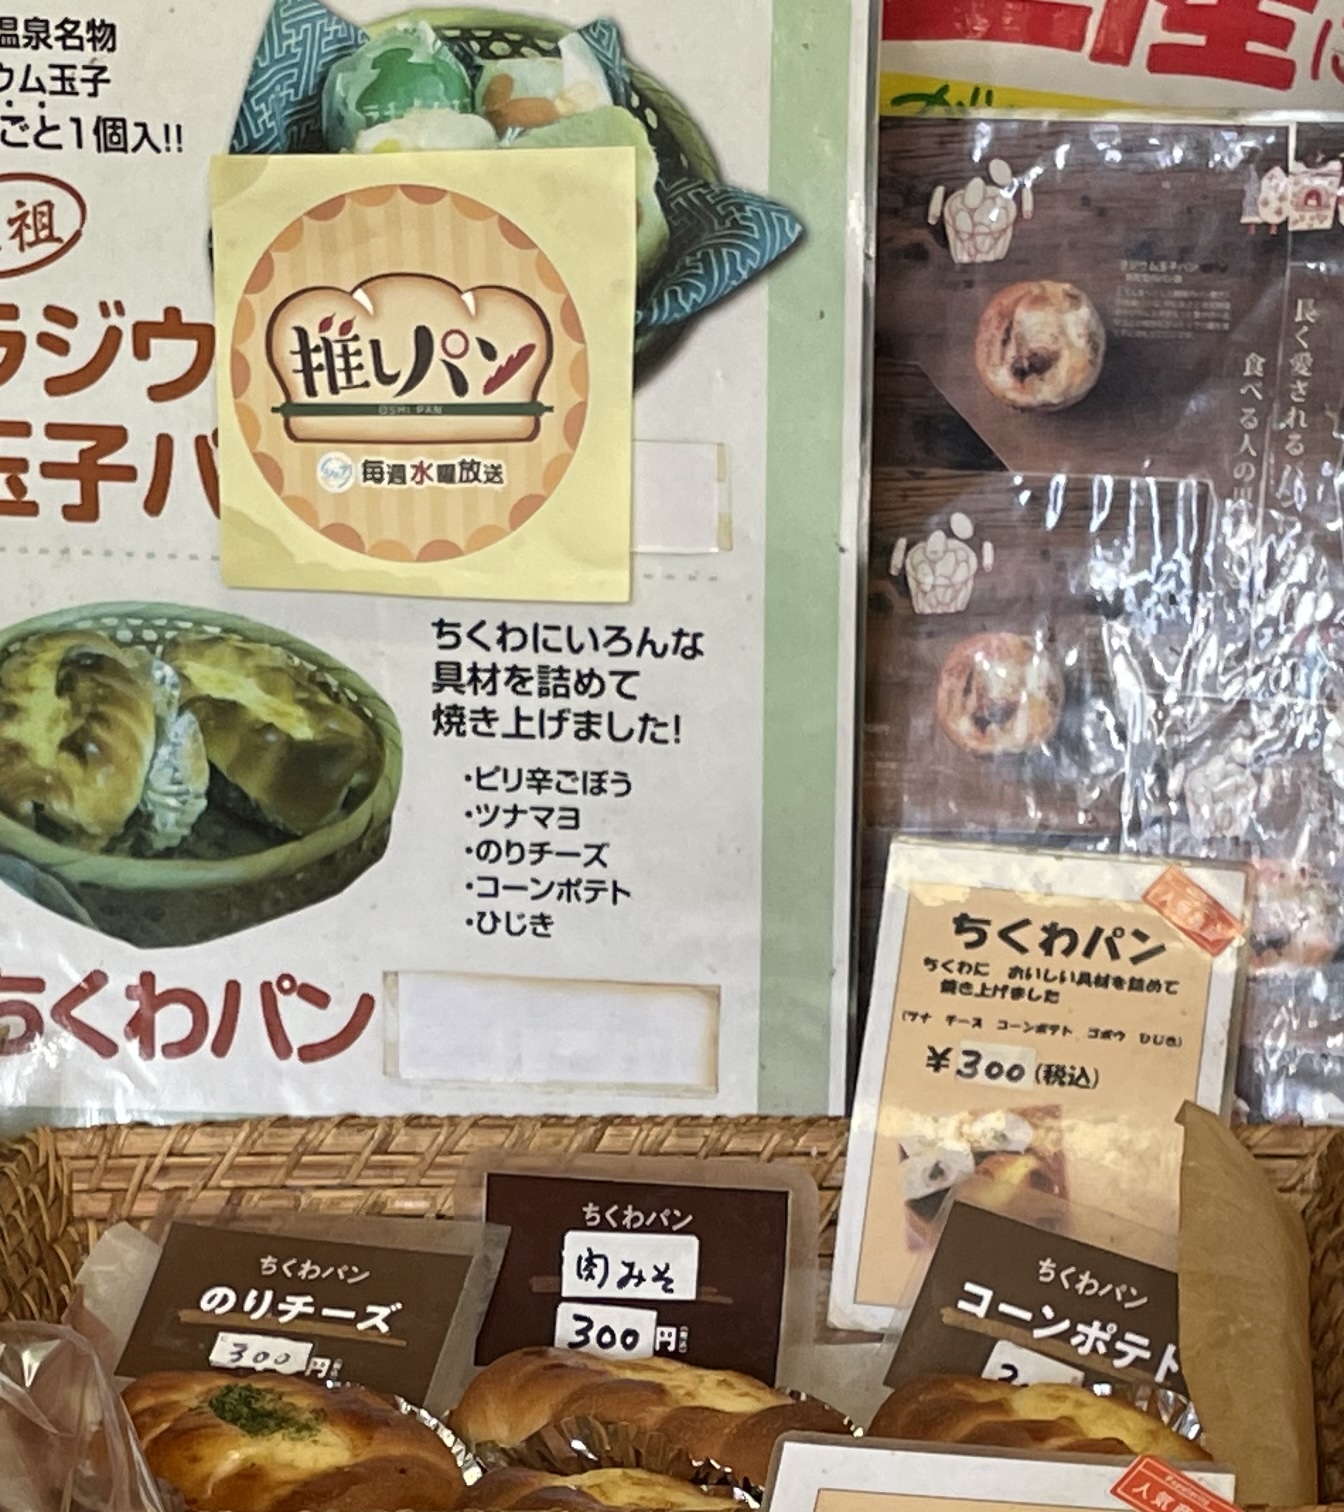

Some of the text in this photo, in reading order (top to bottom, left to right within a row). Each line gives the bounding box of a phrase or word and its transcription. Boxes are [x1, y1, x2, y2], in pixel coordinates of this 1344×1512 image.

[289, 312, 537, 399] 推しパン
[416, 405, 443, 415] PAN
[361, 458, 505, 486] 毎週水曜放送
[430, 616, 705, 660] ちくわにいろんな
[430, 662, 641, 703] 具材を詰めて
[430, 704, 682, 745] 焼き上げました!
[951, 911, 1167, 966] ちくわパン
[922, 956, 1181, 996] ちくわに おいしい具材を詰めて
[939, 978, 1061, 1005] 焼き上げました
[581, 1201, 693, 1232] ちくわパン
[259, 1253, 371, 1284] ちくわパン
[575, 1246, 676, 1296] 肉みそ
[1037, 1256, 1150, 1309] ちくわパン
[199, 1285, 403, 1335] のりチーズ
[957, 1280, 1184, 1384] コーンポテト
